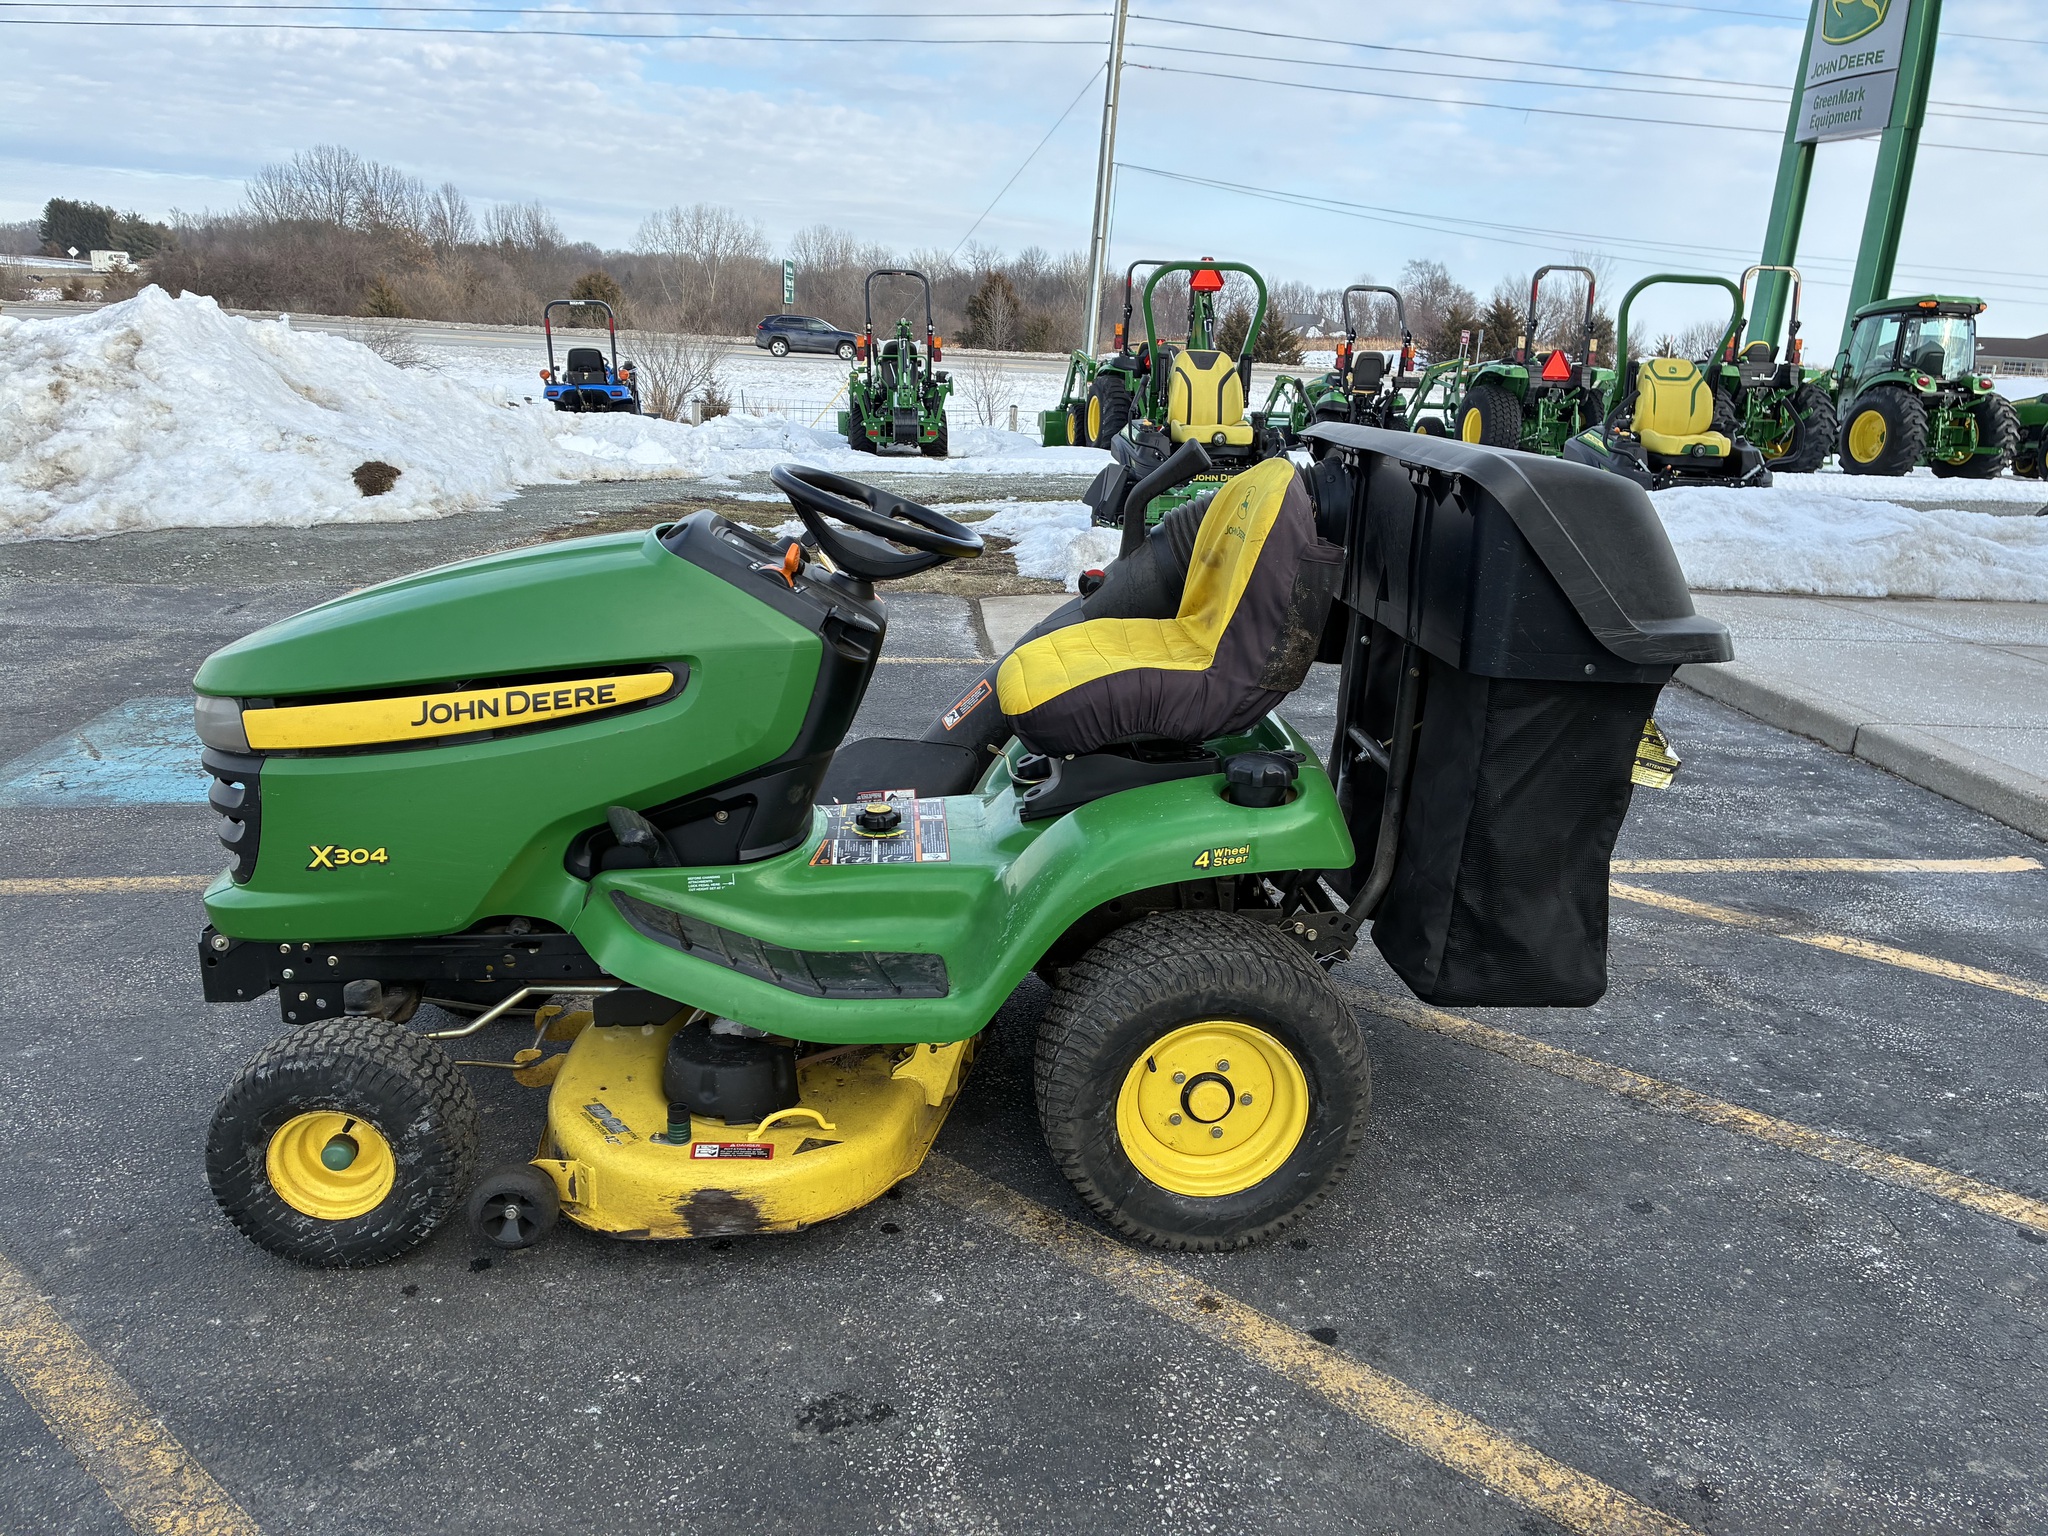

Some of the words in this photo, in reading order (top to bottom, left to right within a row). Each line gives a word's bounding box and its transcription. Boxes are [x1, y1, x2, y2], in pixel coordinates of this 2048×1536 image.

[1811, 59, 1837, 79] JOHN
[1838, 50, 1885, 71] DEERE
[1813, 86, 1865, 110] GreenMark
[1809, 106, 1863, 130] Equipment
[411, 697, 499, 726] JOHN
[506, 683, 617, 717] DEERE
[1646, 762, 1671, 773] ATTENTION
[306, 844, 390, 872] X304
[1193, 849, 1211, 869] 4
[1213, 844, 1250, 858] Wheel
[1213, 855, 1248, 867] Steer
[582, 1103, 631, 1134] EDGE
